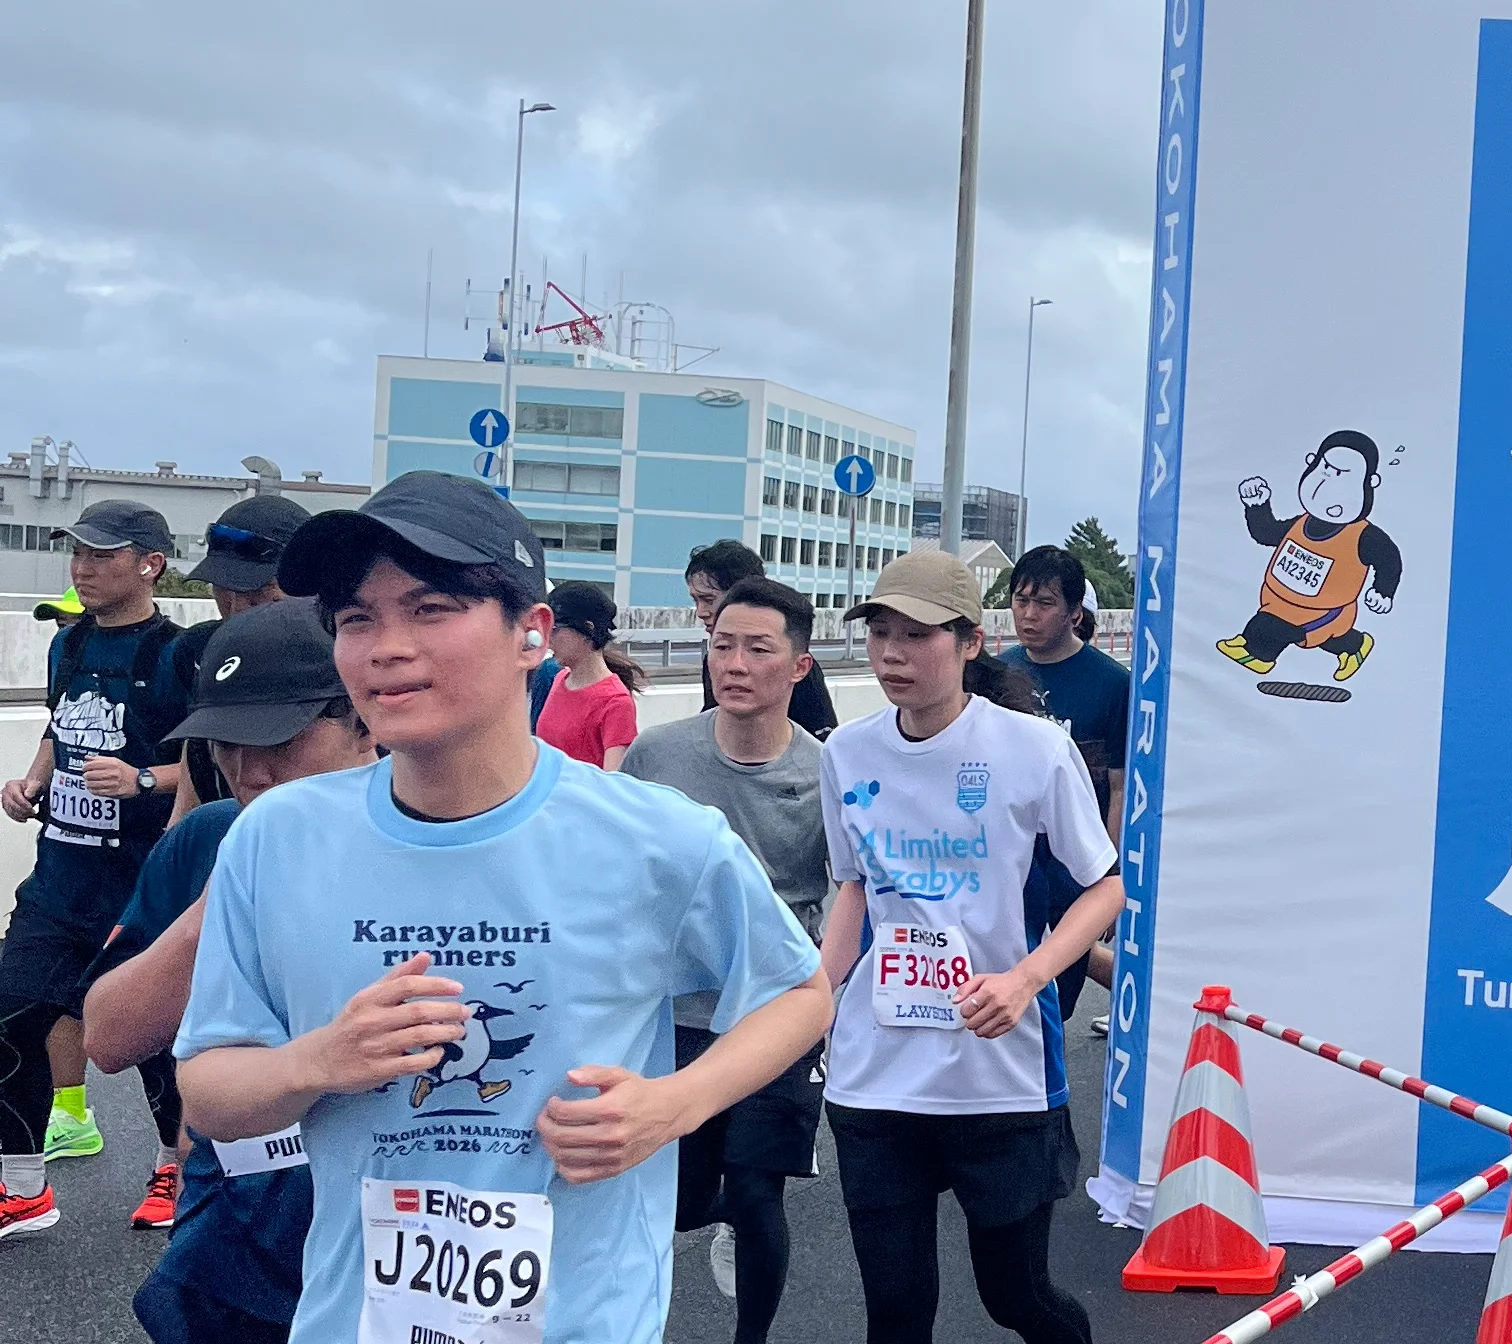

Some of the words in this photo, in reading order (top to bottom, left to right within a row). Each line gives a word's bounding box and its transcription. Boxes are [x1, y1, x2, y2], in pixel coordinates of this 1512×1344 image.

[1277, 556, 1321, 587] A12345
[1294, 549, 1325, 570] ENEOS
[65, 777, 86, 789] ENE
[52, 791, 116, 820] D11083
[885, 823, 989, 859] Limited
[1111, 545, 1163, 1109] MARATHON
[866, 853, 981, 900] Szabys
[352, 919, 552, 947] Karayaburi
[264, 1135, 302, 1159] PU
[434, 1138, 482, 1153] 2026
[425, 1189, 517, 1229] ENEOS
[374, 1230, 542, 1308] J20269
[515, 1313, 531, 1322] 22
